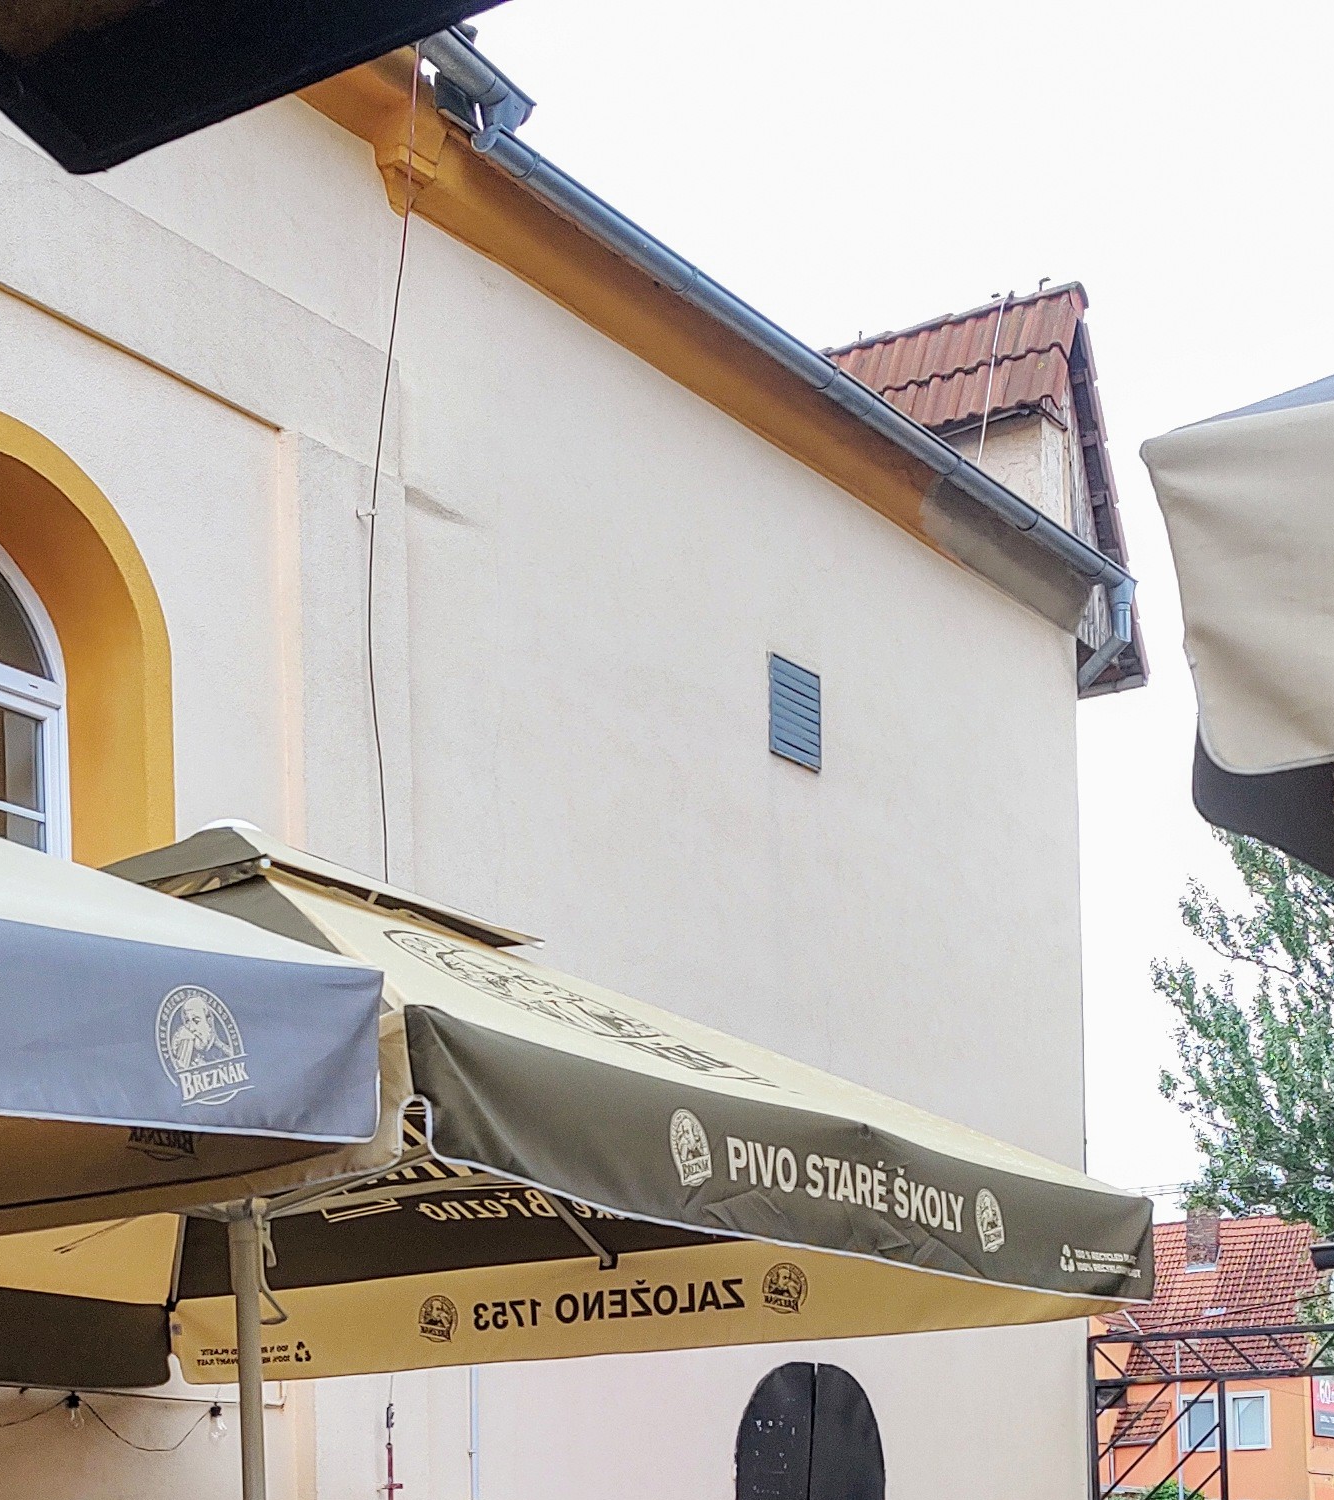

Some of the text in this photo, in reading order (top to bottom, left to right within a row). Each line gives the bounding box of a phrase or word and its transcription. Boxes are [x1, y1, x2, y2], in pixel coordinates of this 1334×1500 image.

[179, 1062, 249, 1101] BŘEZŇÁK
[726, 1135, 964, 1233] PIVO STARÉ ŠKOLY
